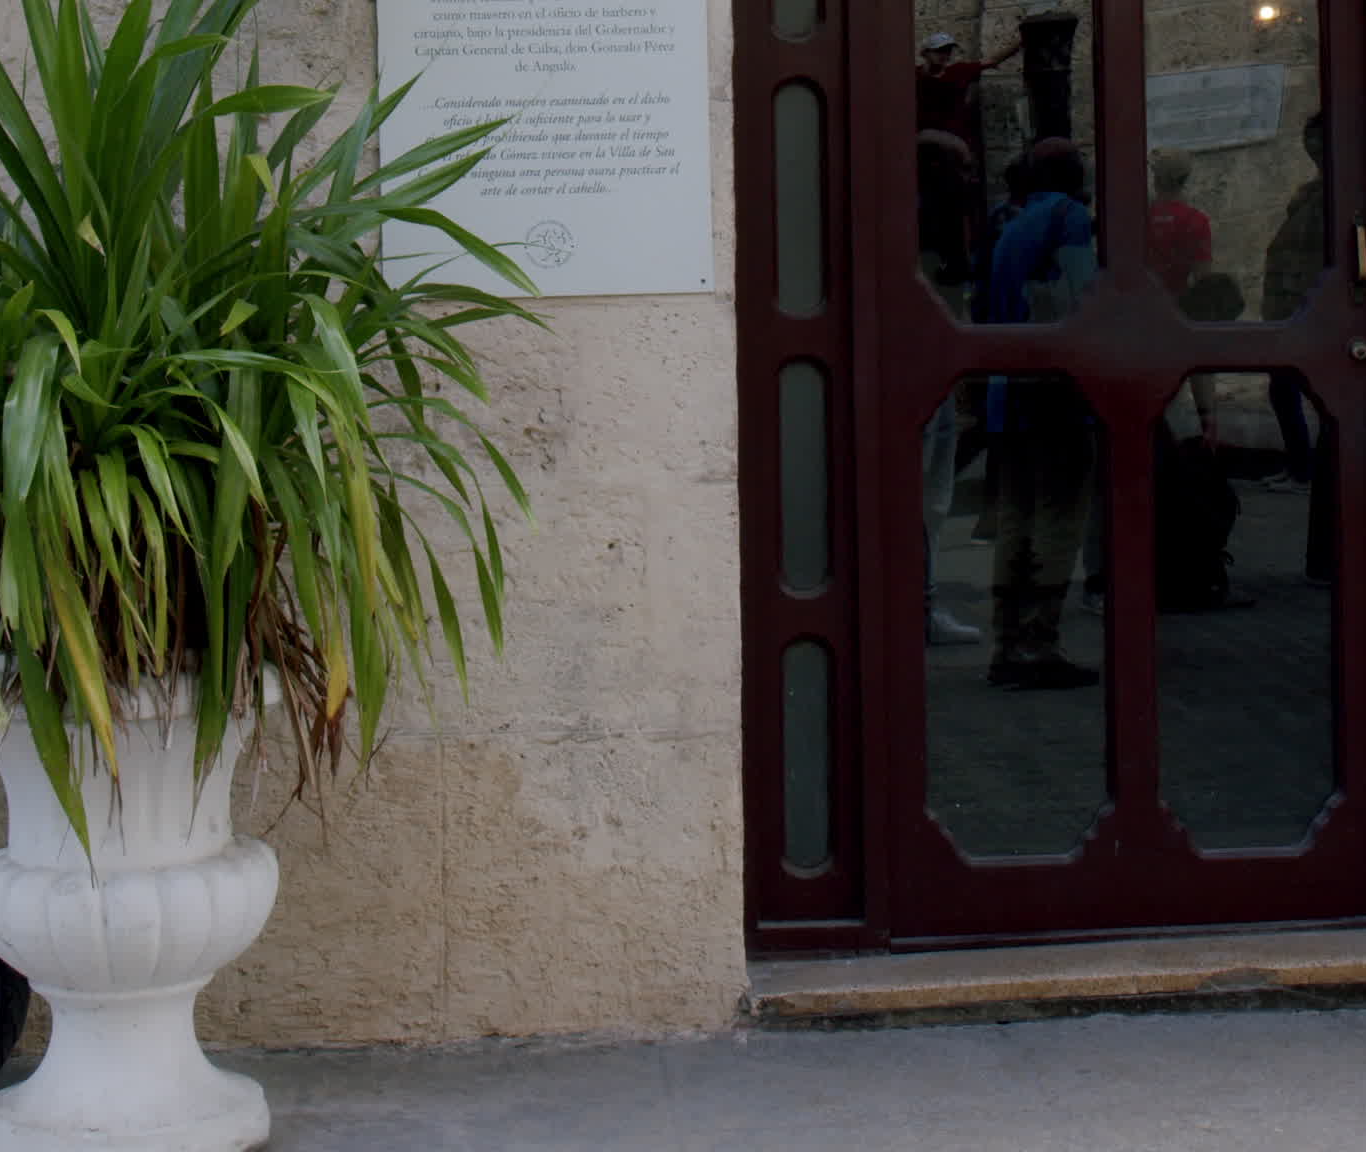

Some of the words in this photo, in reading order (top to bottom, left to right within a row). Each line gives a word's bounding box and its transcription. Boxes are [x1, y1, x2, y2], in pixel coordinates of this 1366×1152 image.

[432, 10, 467, 21] como
[469, 9, 514, 20] maestro
[516, 9, 532, 19] en
[535, 7, 545, 19] el
[548, 6, 581, 18] oficio
[585, 7, 600, 18] de
[602, 6, 646, 18] barbero
[414, 28, 464, 41] cirujano,
[466, 26, 492, 41] bajo
[495, 26, 504, 38] la
[507, 25, 572, 41] presidencia
[575, 24, 592, 37] del
[595, 23, 667, 36] Gobernador
[415, 44, 459, 60] Capitán
[462, 44, 508, 56] General
[511, 43, 525, 55] de
[528, 41, 562, 55] Cuba,
[565, 41, 588, 54] don
[591, 40, 641, 54] Gonzalo
[644, 39, 675, 54] Pérez
[515, 60, 529, 73] de
[532, 58, 578, 76] Angulo.
[550, 94, 610, 107] examinado
[612, 96, 626, 105] en
[628, 91, 639, 105] el
[641, 91, 671, 105] dicho
[443, 114, 472, 129] oficio
[524, 113, 574, 128] suficiente
[576, 113, 603, 127] para
[605, 112, 616, 123] lo
[618, 113, 642, 123] usar
[552, 132, 572, 145] que
[574, 129, 618, 142] durante
[619, 128, 630, 141] el
[632, 129, 669, 144] tiempo
[500, 147, 538, 161] Gómez
[541, 150, 578, 160] viviese
[579, 151, 592, 159] en
[595, 147, 605, 158] la
[610, 145, 636, 158] Villa
[639, 145, 652, 157] de
[655, 144, 675, 157] San
[471, 169, 517, 183] ninguna
[543, 168, 585, 181] persona
[618, 164, 667, 180] practicar
[669, 160, 682, 175] el
[480, 185, 502, 196] arte
[506, 183, 518, 196] de
[520, 185, 554, 196] cortar
[556, 182, 566, 195] el
